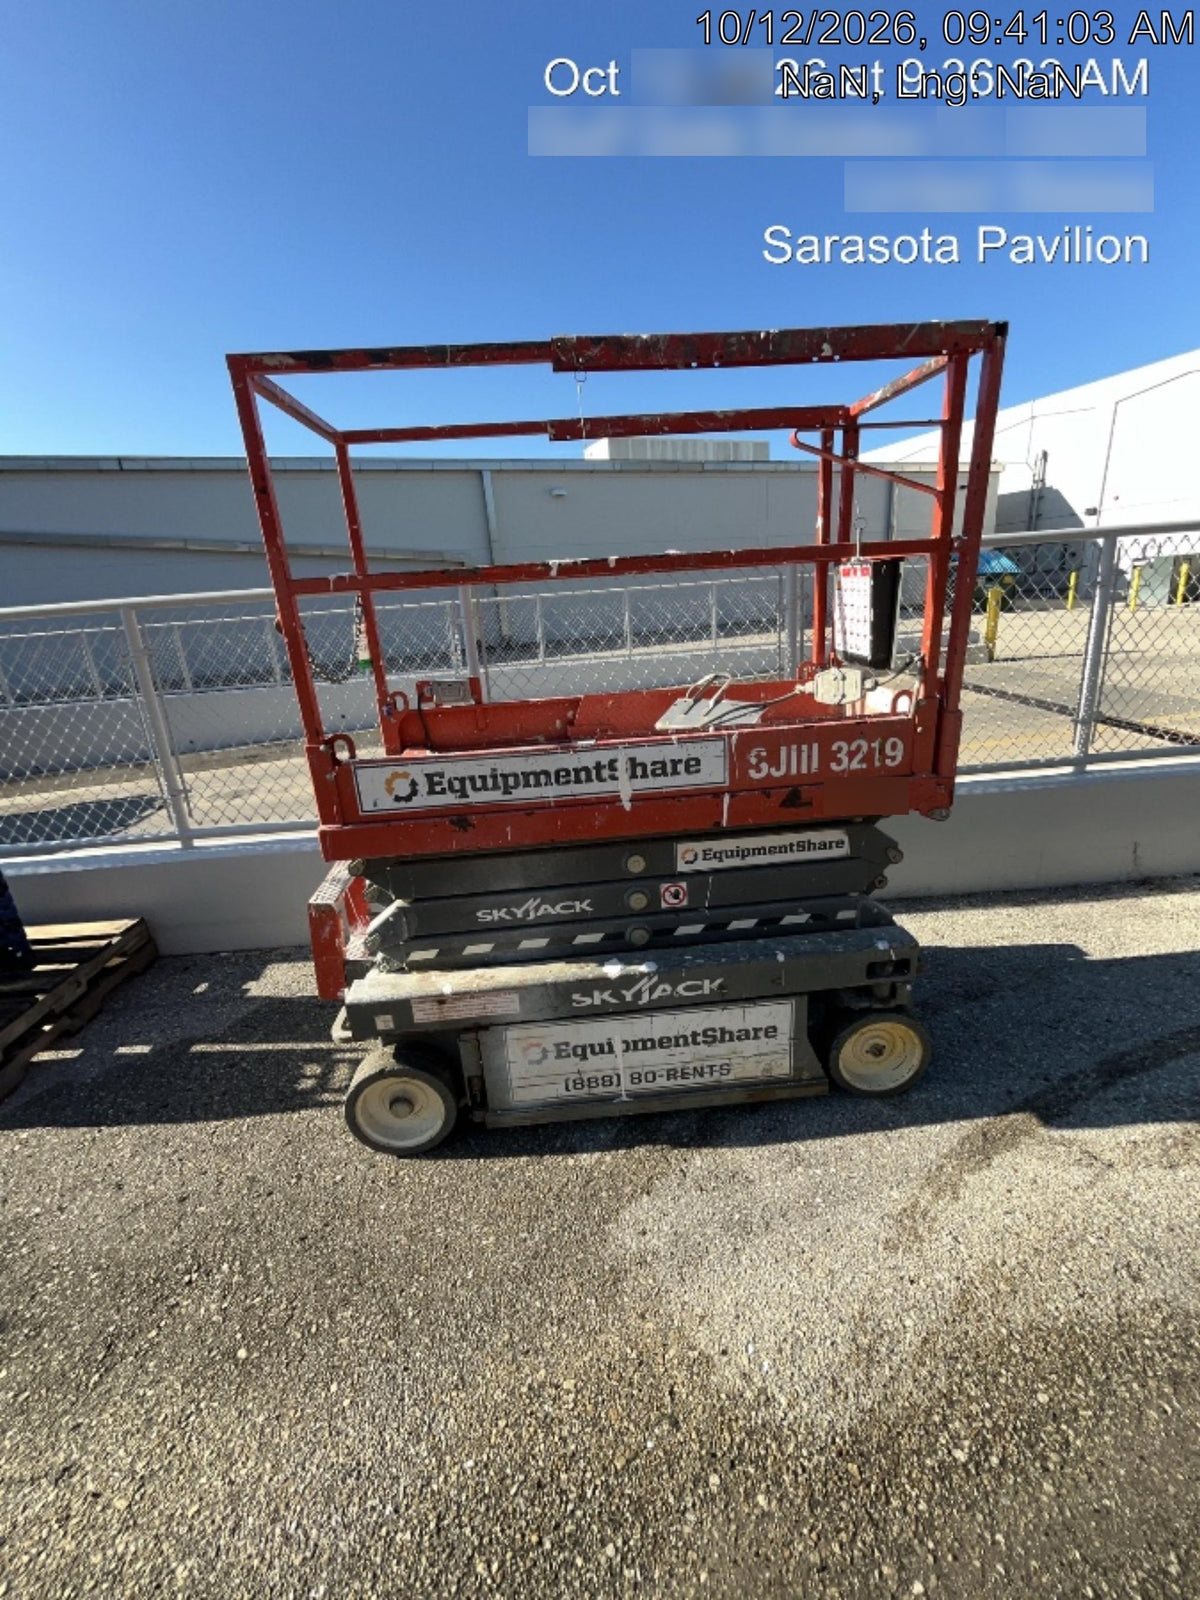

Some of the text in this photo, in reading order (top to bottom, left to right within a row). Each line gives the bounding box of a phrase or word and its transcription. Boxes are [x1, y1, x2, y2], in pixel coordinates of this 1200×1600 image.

[829, 737, 905, 772] 3219
[424, 755, 702, 798] EquipmentShare
[701, 837, 846, 863] EquipmentShare
[475, 897, 594, 922] SKYJACK
[571, 974, 725, 1006] SKYJACK
